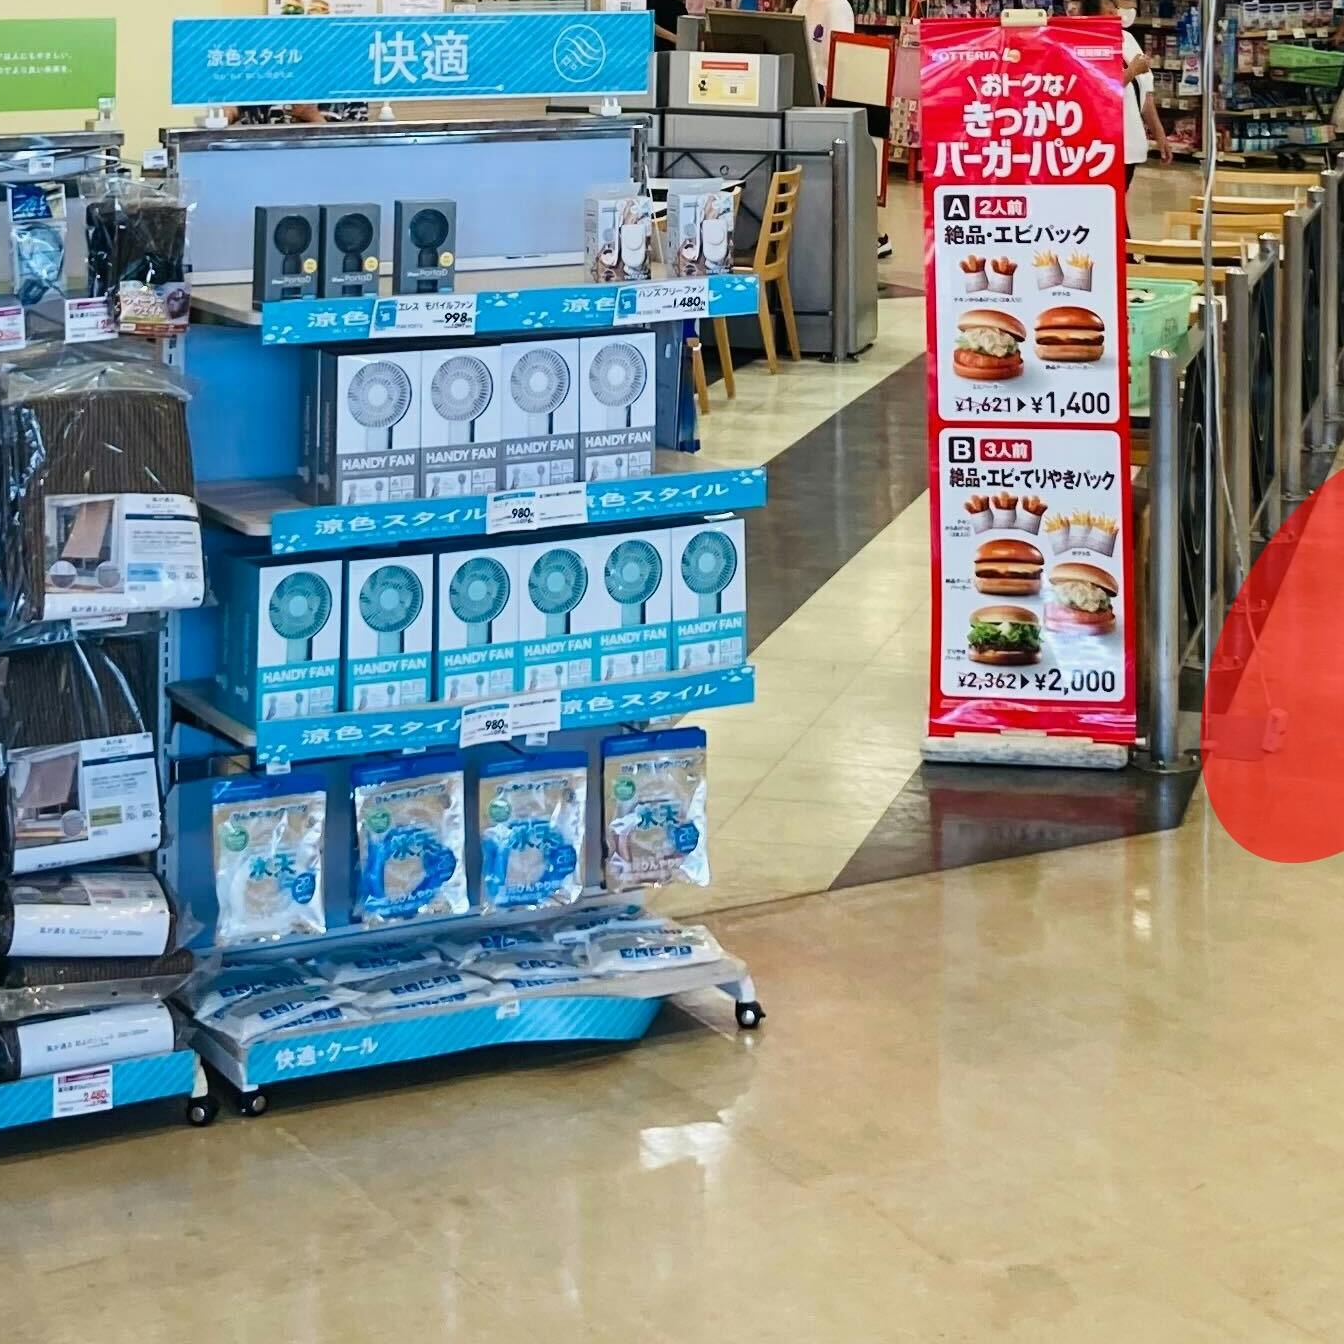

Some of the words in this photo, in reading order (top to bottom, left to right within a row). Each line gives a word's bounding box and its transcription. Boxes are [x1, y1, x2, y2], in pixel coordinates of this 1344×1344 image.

[207, 48, 302, 67] 涼色スタイル
[368, 30, 469, 85] 快適
[981, 73, 1064, 97] おトクな
[963, 100, 1083, 137] きっかり
[934, 138, 1115, 177] バーガーパック
[948, 198, 966, 218] A
[980, 200, 1025, 215] 2人前
[944, 225, 1090, 245] 絶品・エビパック
[1031, 391, 1110, 417] ¥1,400
[506, 439, 546, 455] HANDY
[549, 437, 574, 452] FAN
[585, 432, 624, 448] HANDY
[627, 430, 651, 445] FAN
[426, 448, 467, 465] HANDY
[470, 446, 497, 462] FAN
[953, 441, 971, 459] B
[985, 443, 1028, 458] 3人前
[342, 455, 385, 472] HANDY
[388, 453, 415, 468] FAN
[950, 468, 1115, 490] 絶品・エビ・てりやきパック
[601, 630, 639, 648] HANDY
[642, 627, 667, 643] FAN
[678, 620, 715, 638] HANDY
[718, 616, 742, 633] FAN
[445, 650, 485, 667] HANDY
[488, 646, 514, 662] FAN
[524, 640, 564, 658] HANDY
[567, 636, 591, 652] FAN
[263, 667, 305, 684] HANDY
[308, 663, 334, 679] FAN
[353, 660, 396, 676] HANDY
[399, 657, 426, 671] FAN
[1036, 668, 1115, 694] ¥2,000
[275, 1036, 378, 1071] 快適・クール
